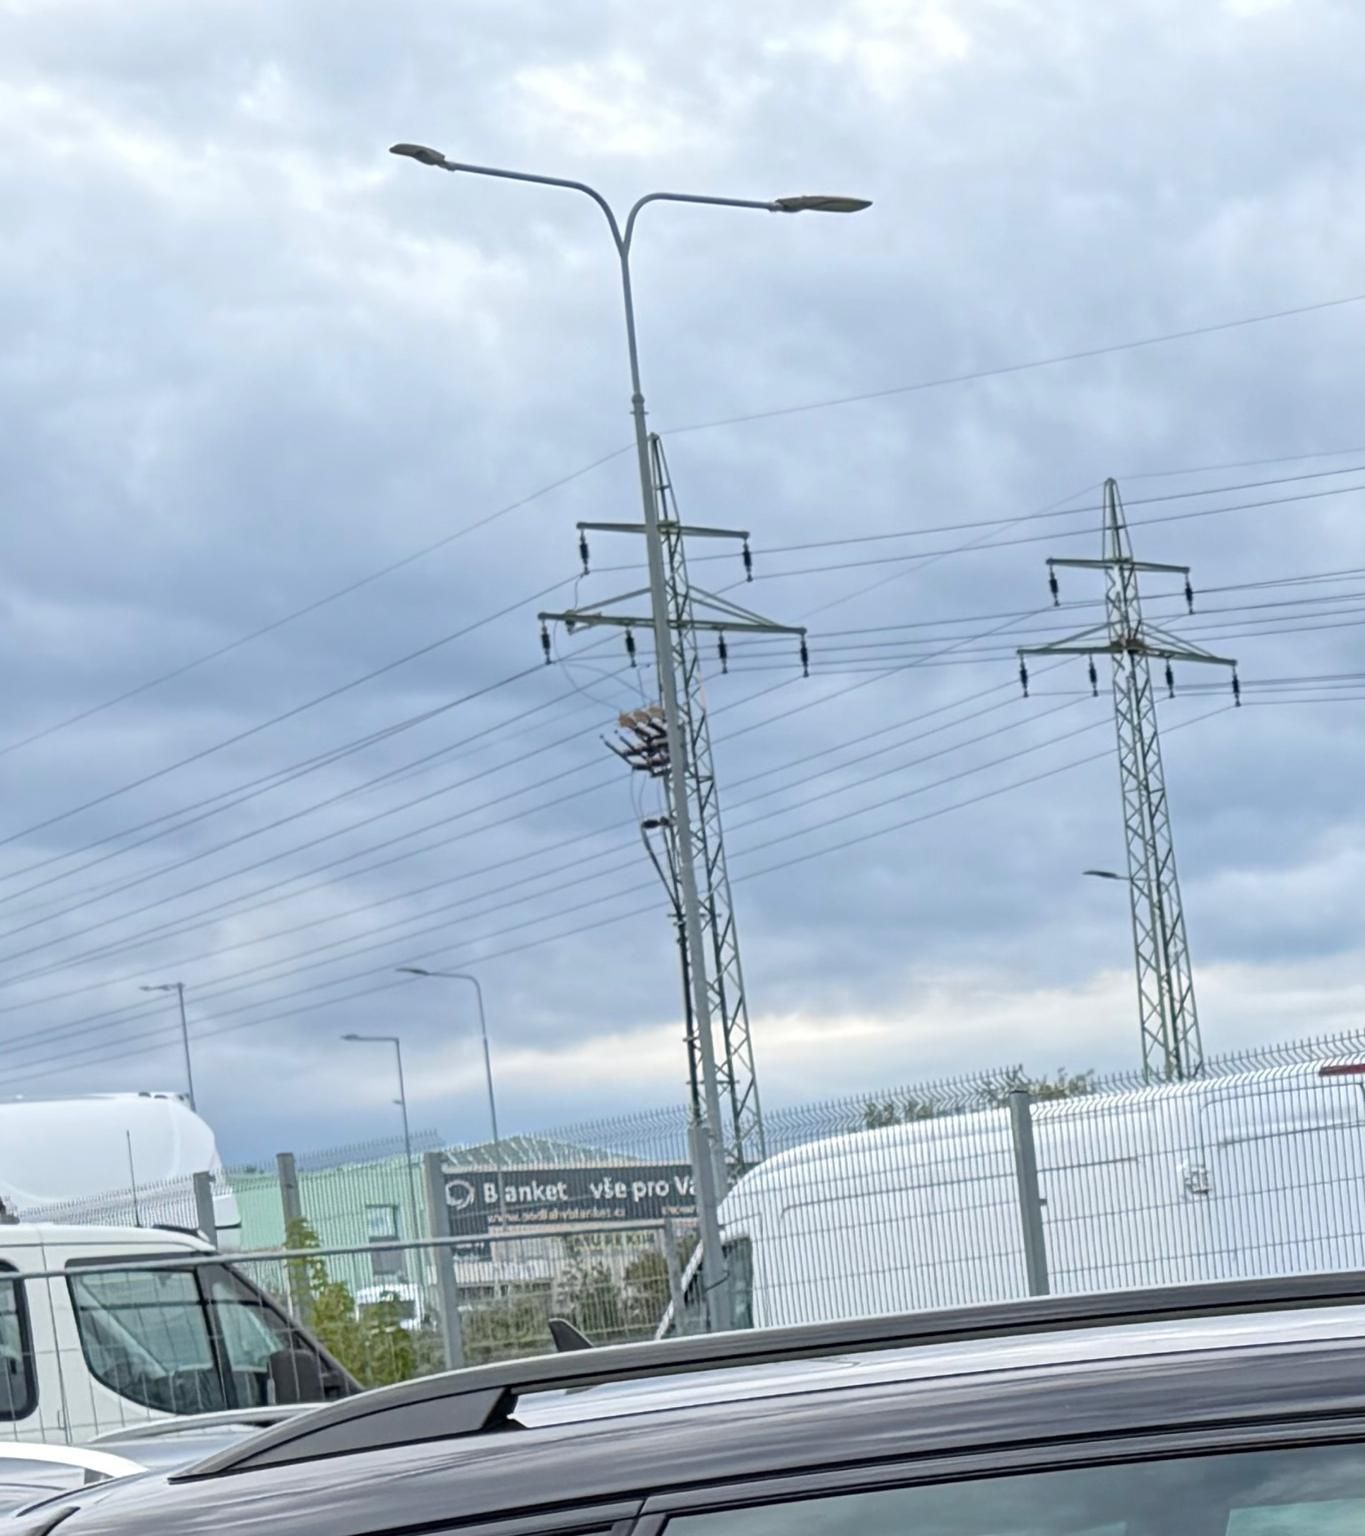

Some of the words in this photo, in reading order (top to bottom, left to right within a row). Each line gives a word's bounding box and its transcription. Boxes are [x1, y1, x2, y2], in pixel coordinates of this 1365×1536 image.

[483, 1180, 568, 1203] Banket
[590, 1176, 628, 1200] vše
[632, 1178, 669, 1202] pro
